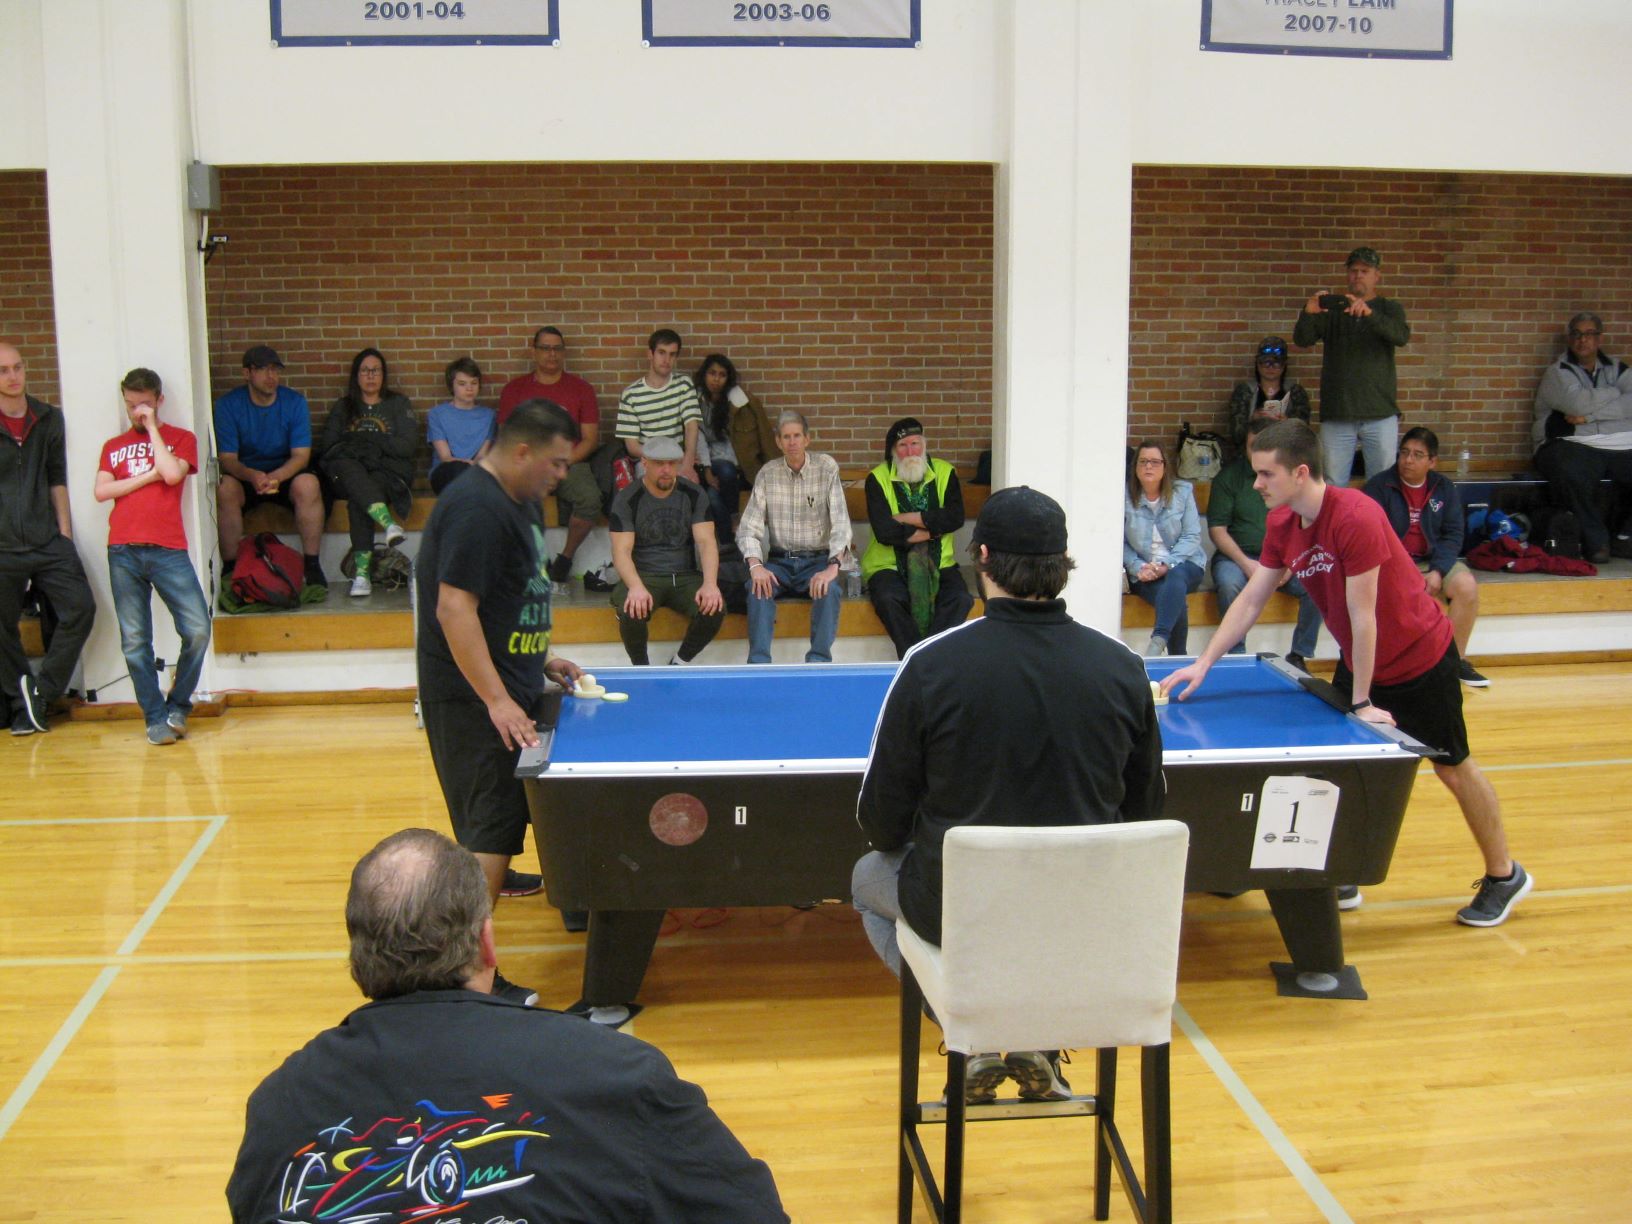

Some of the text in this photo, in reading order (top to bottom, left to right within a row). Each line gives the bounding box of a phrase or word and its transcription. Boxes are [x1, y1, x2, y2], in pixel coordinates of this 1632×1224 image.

[364, 1, 465, 20] 2001-04
[733, 3, 831, 21] 2003-06
[1283, 14, 1373, 34] 2007-10
[1286, 800, 1300, 833] 1
